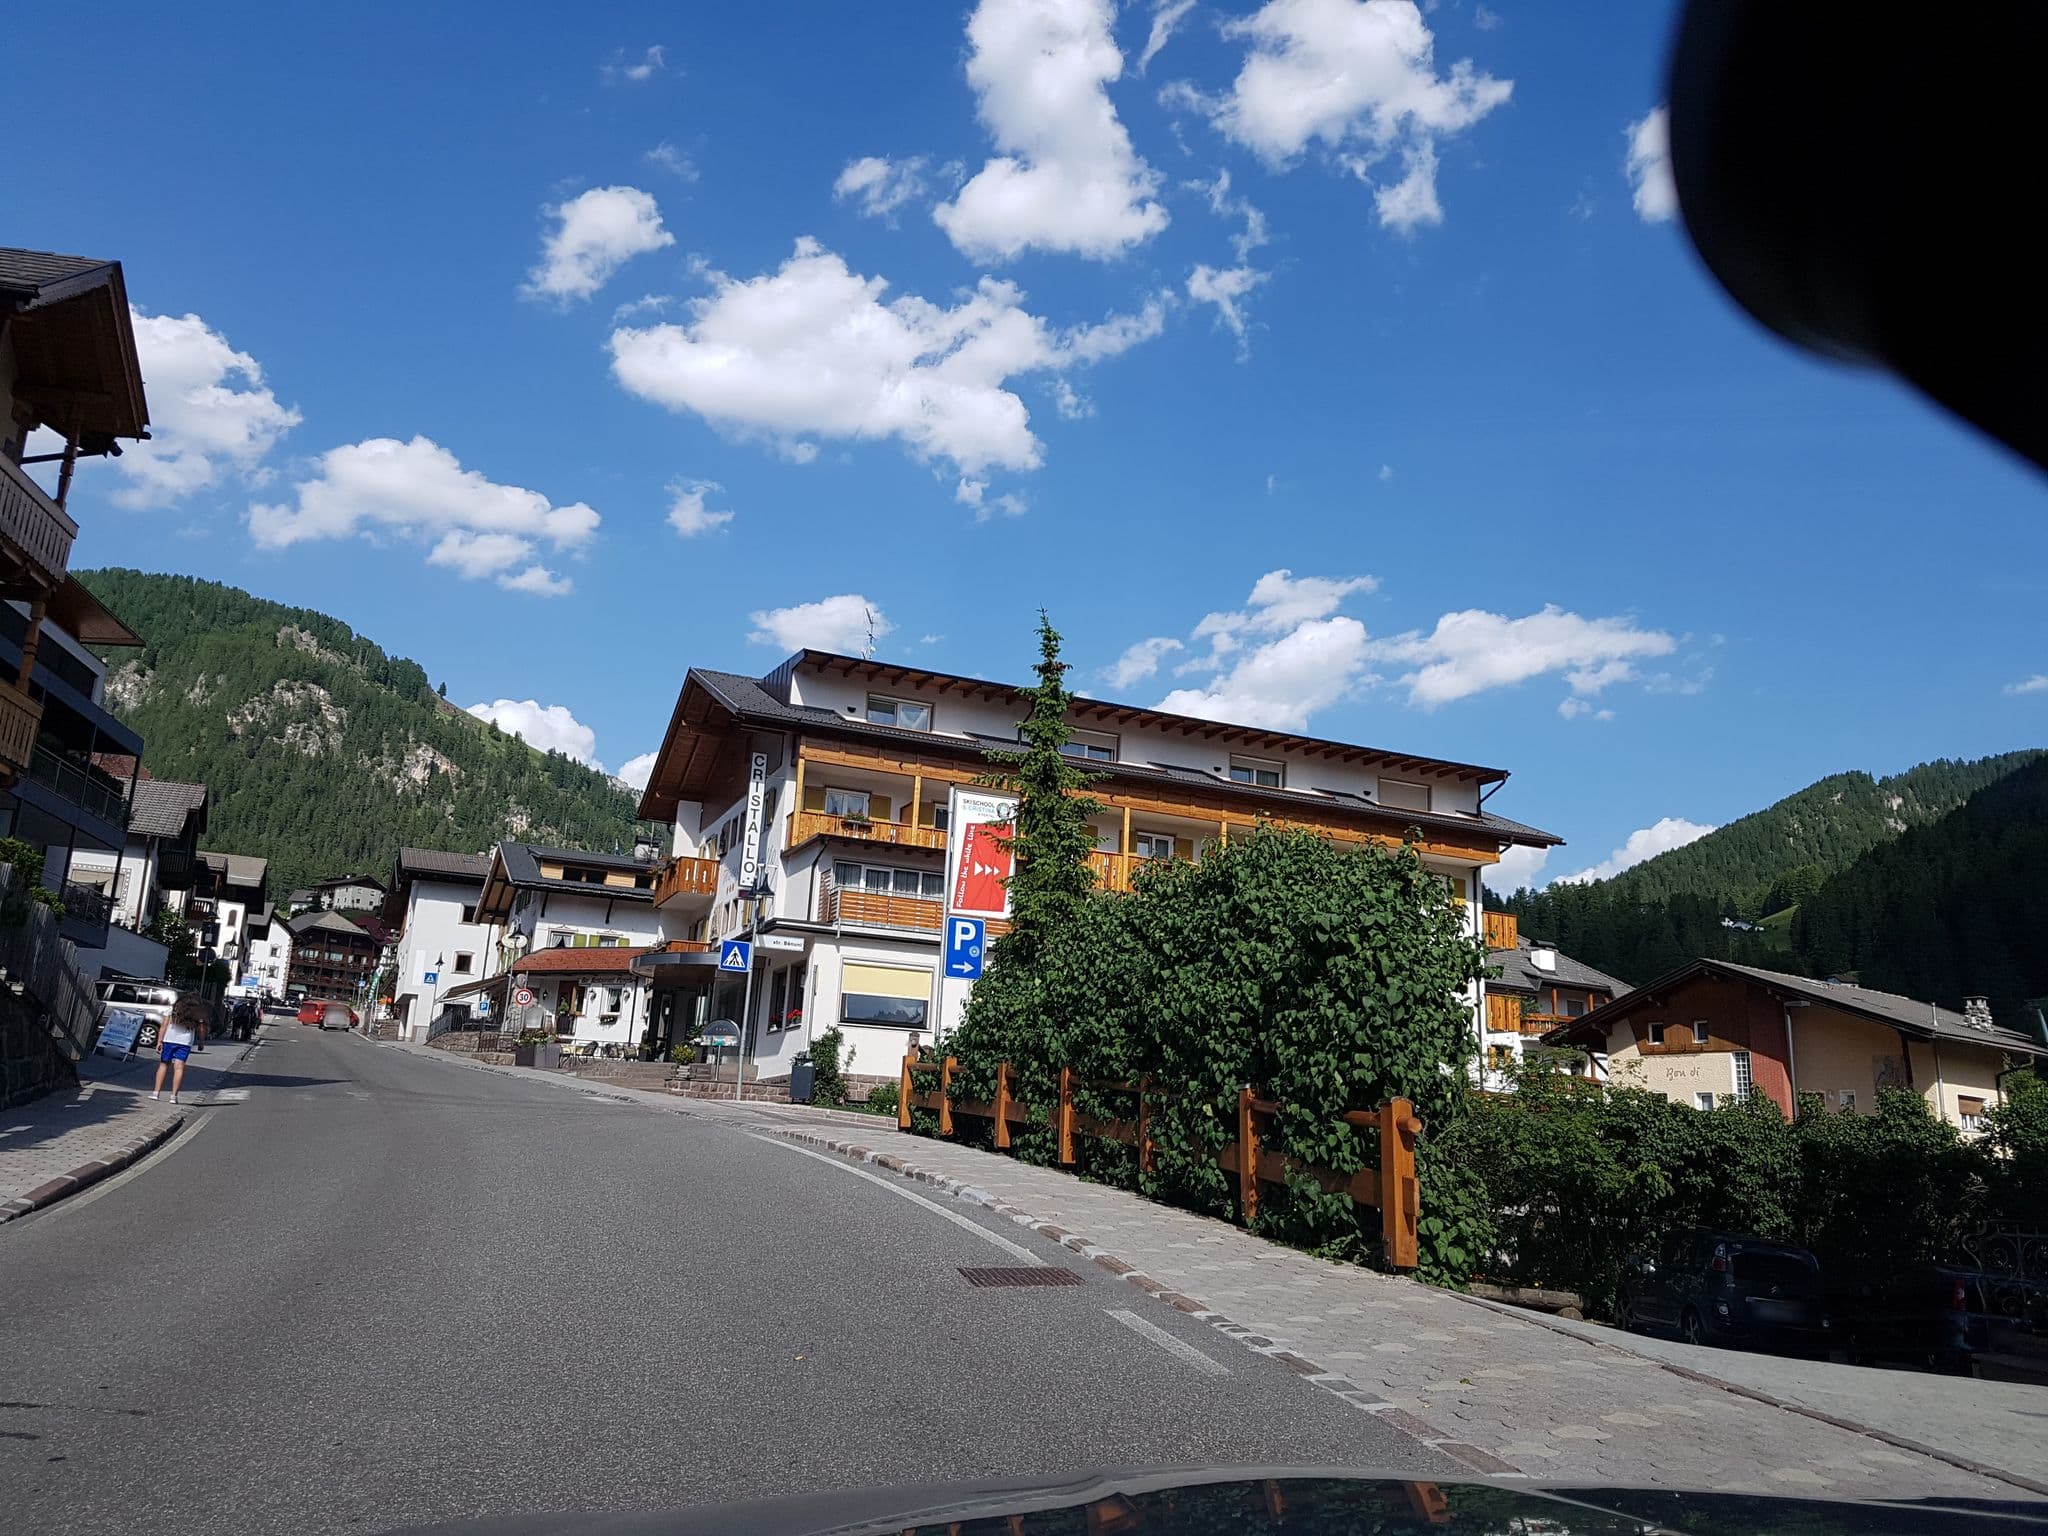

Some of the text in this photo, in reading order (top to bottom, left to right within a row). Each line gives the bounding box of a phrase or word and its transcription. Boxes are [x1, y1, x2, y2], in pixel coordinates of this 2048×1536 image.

[973, 800, 995, 808] SCHOOL
[744, 755, 765, 874] CRISTALLO
[964, 843, 973, 863] white
[960, 866, 969, 878] the
[954, 920, 976, 950] P
[519, 993, 529, 1001] 30
